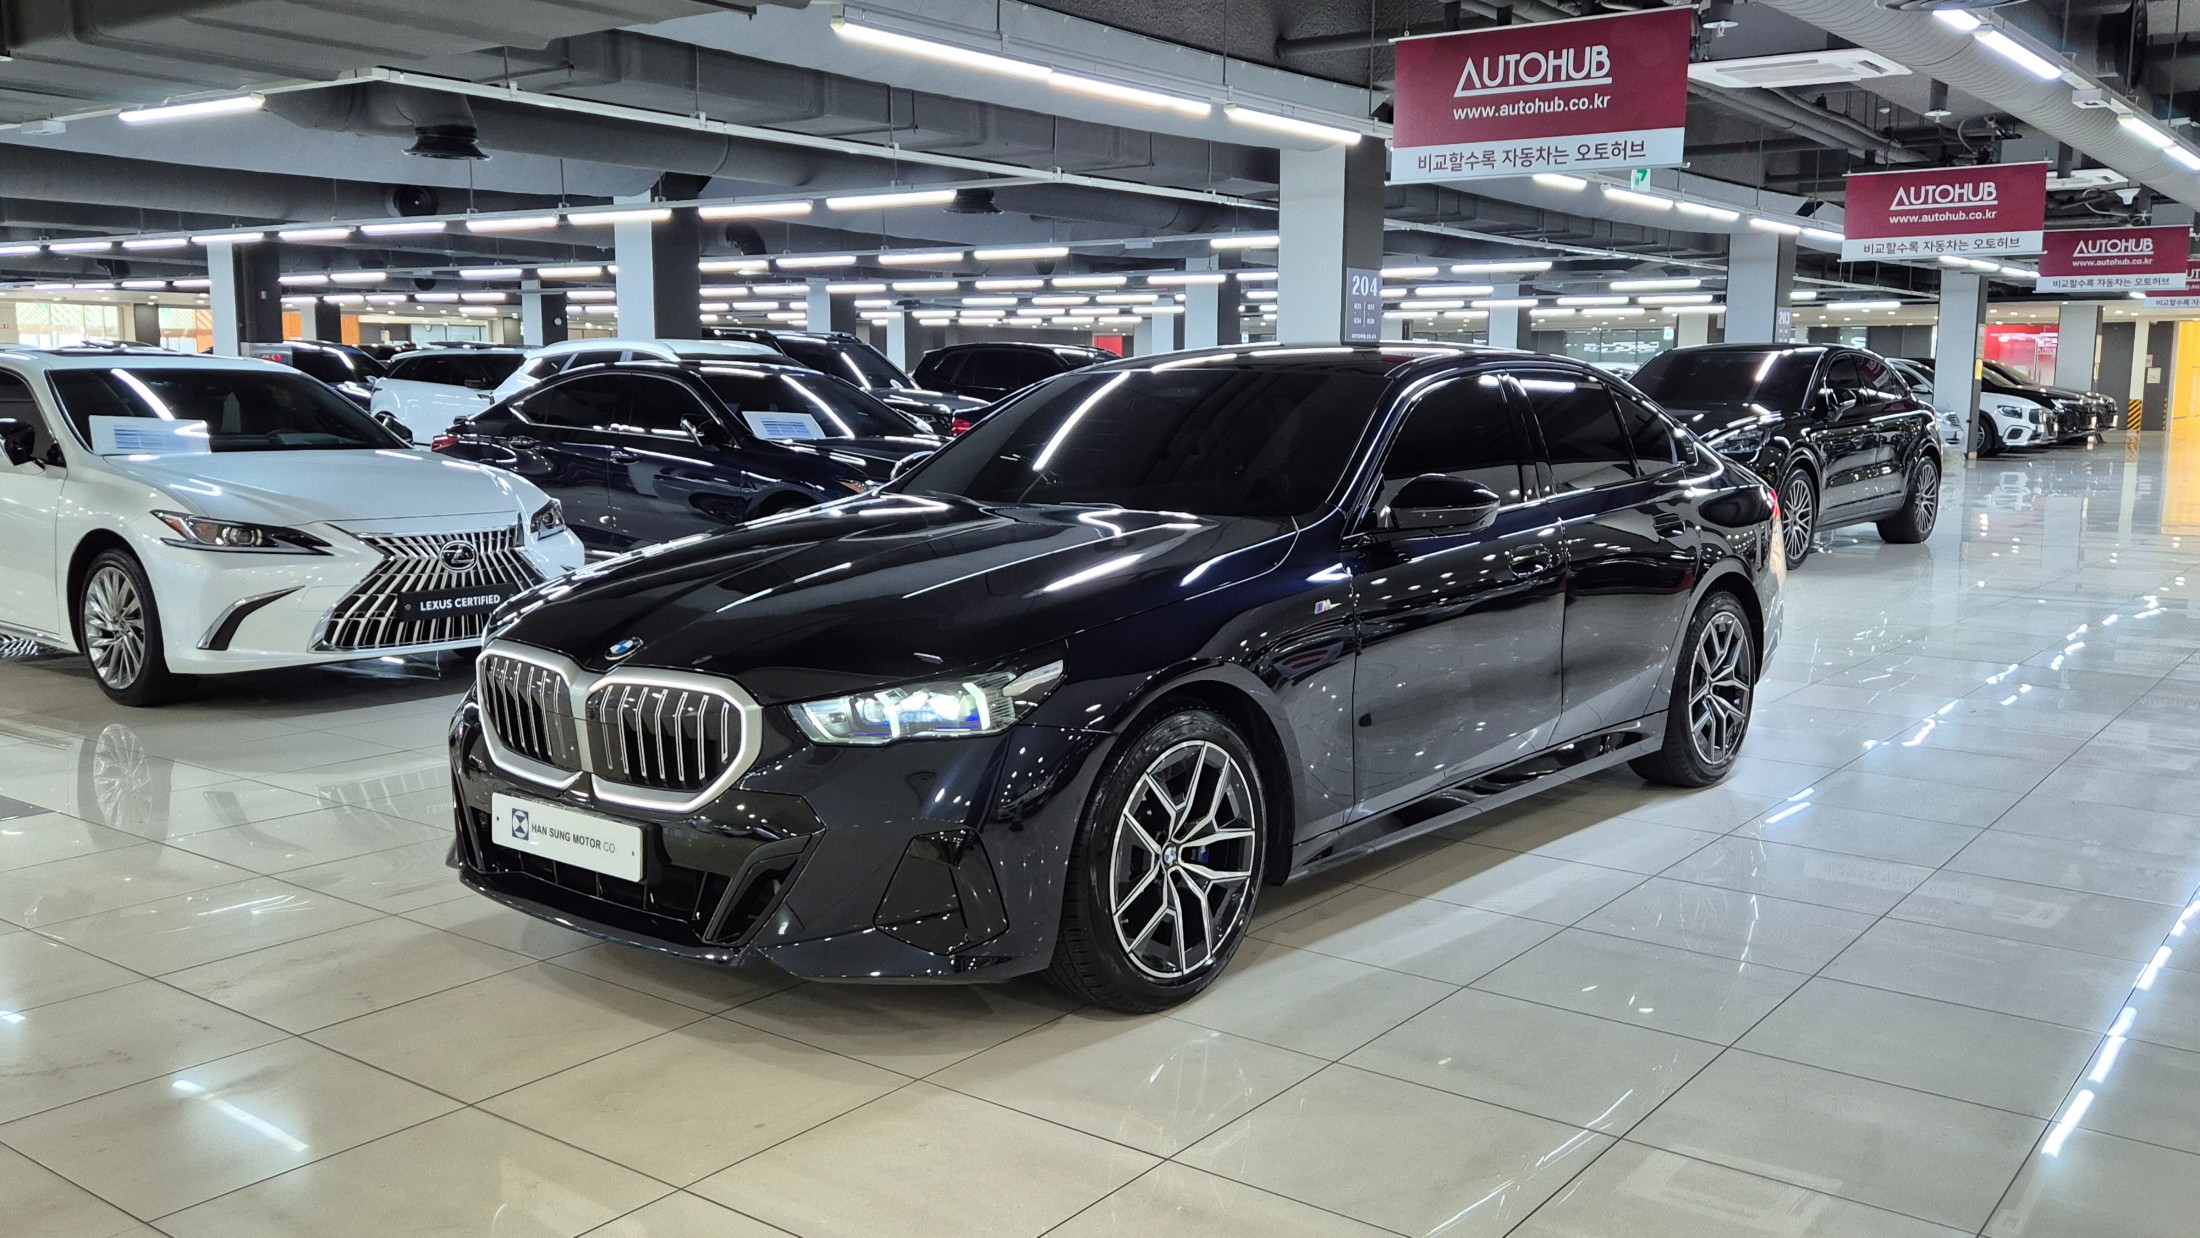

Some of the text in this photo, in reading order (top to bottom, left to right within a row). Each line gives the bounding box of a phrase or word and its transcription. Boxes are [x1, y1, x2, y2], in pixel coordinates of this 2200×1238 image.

[1453, 44, 1613, 98] AUTOHUB
[1452, 93, 1611, 120] www.autohub.co.kr
[1417, 140, 1647, 173] 비교할수록 자동차는 오토허브
[1889, 181, 1998, 211] AUTOHUB
[1889, 209, 1998, 224] www.autohub.co.kr
[1863, 237, 2021, 255] 비교할수록 자동차는 오토허브
[2072, 237, 2154, 257] AUTOHUB
[2072, 257, 2153, 267] www.autohub.co.kr
[1352, 274, 1378, 297] 204
[420, 594, 501, 612] LEXUS CERTIFIED
[531, 822, 548, 836] HAN
[549, 827, 571, 842] SUNG
[572, 834, 602, 850] MOTOR
